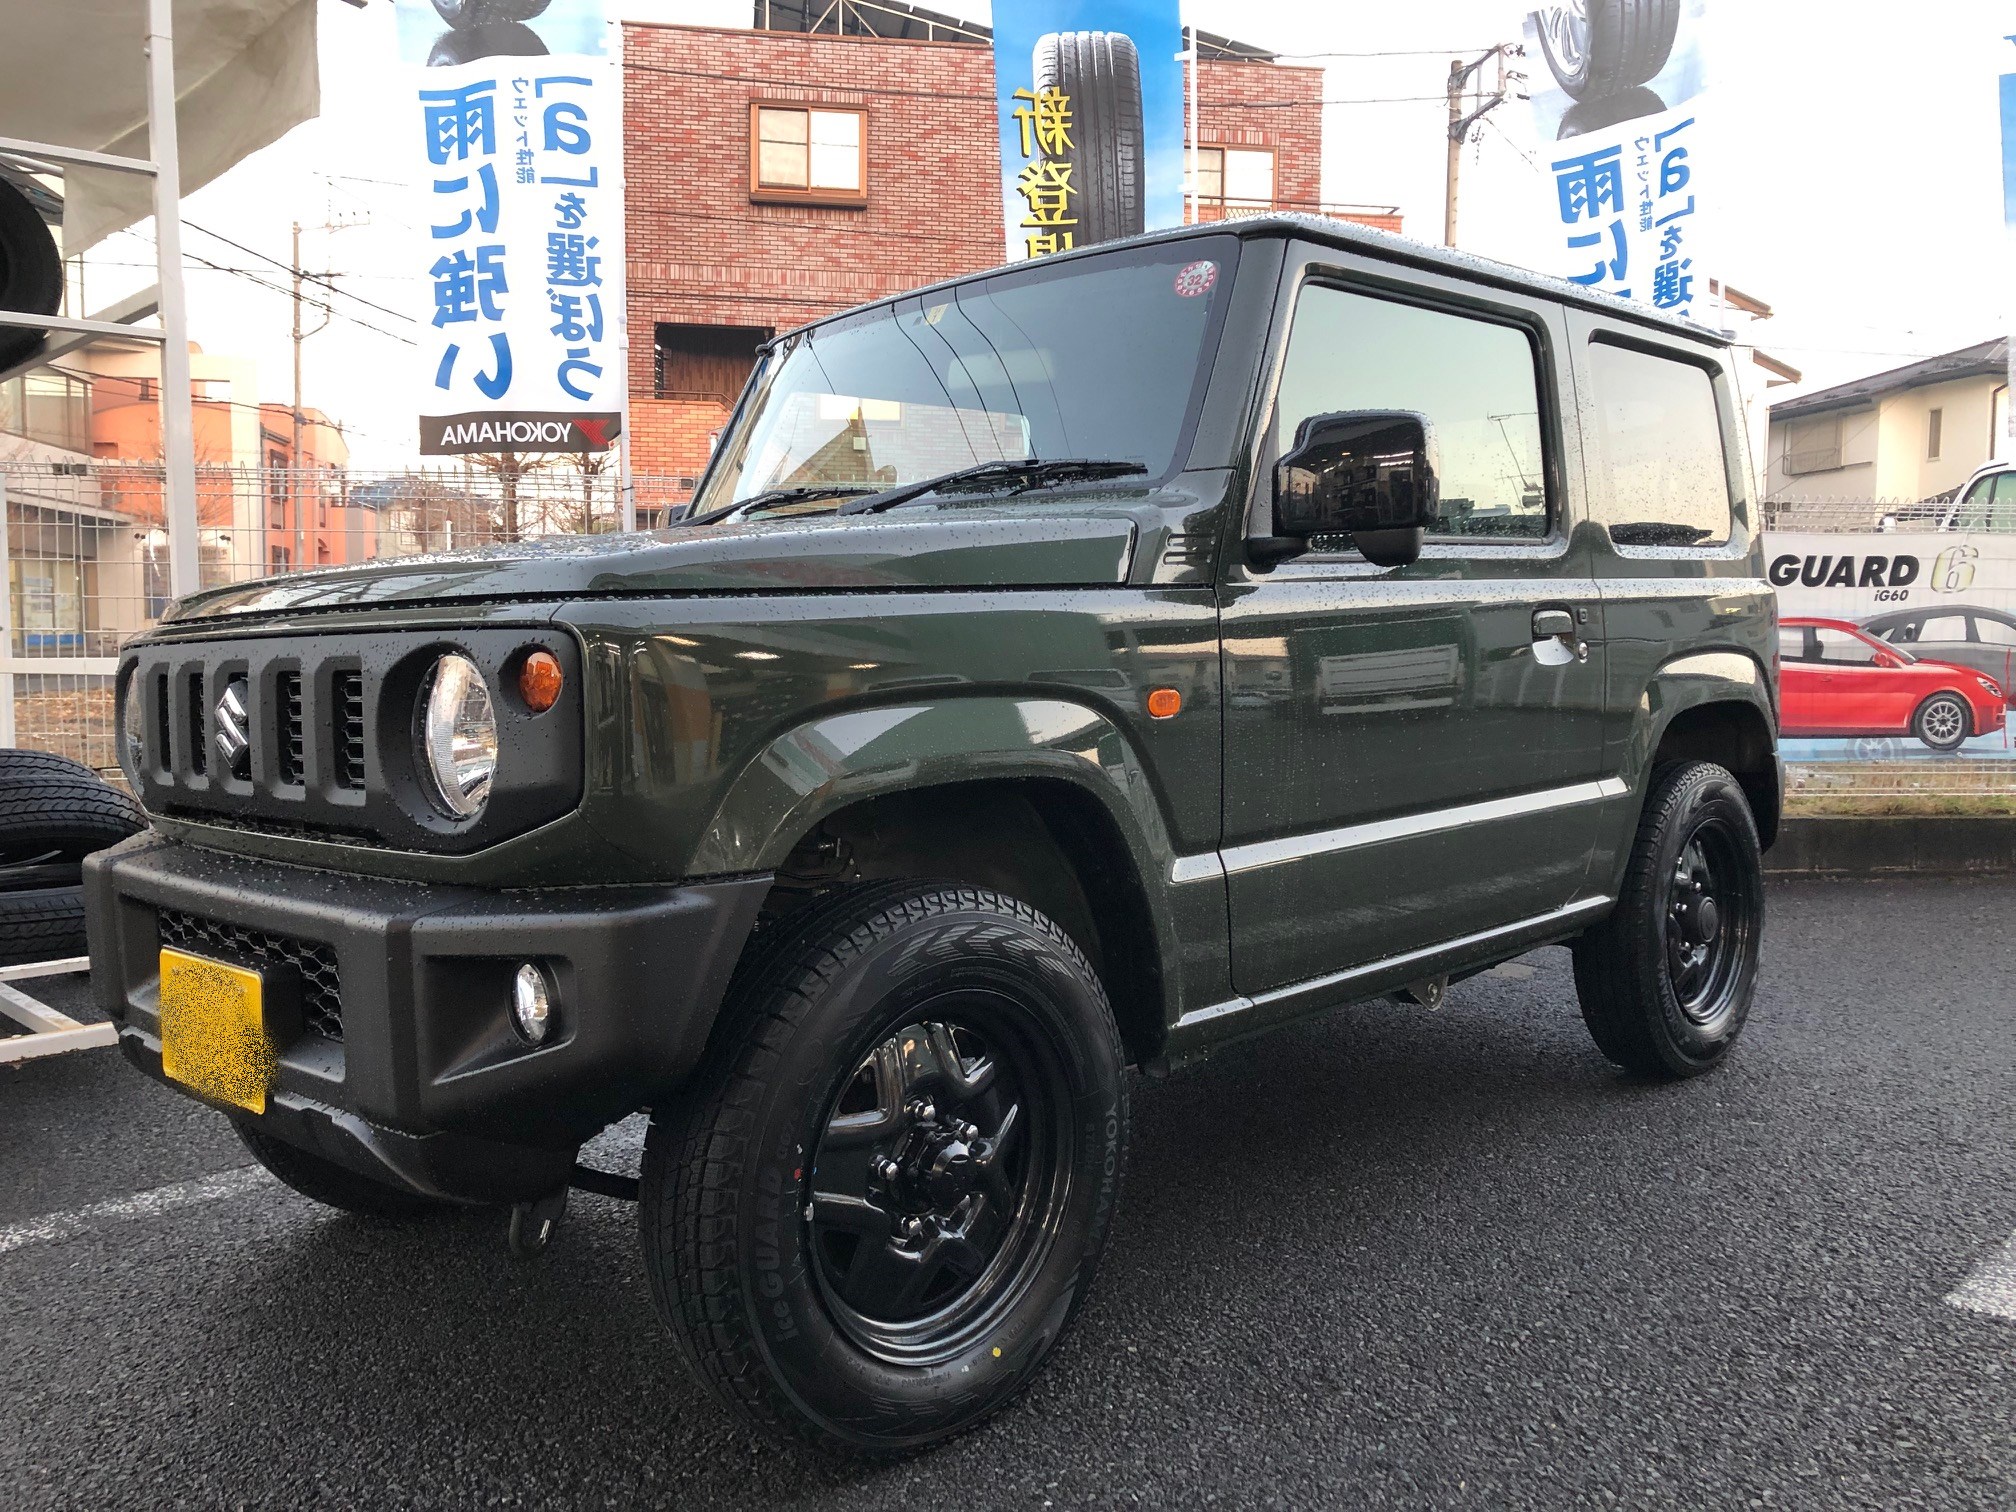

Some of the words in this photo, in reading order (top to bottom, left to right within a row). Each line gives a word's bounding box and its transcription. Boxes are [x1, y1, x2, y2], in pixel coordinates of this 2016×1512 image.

[1187, 273, 1203, 286] 32
[1768, 554, 1920, 588] GUARD
[1930, 545, 1979, 594] 6
[1873, 589, 1909, 602] iG60
